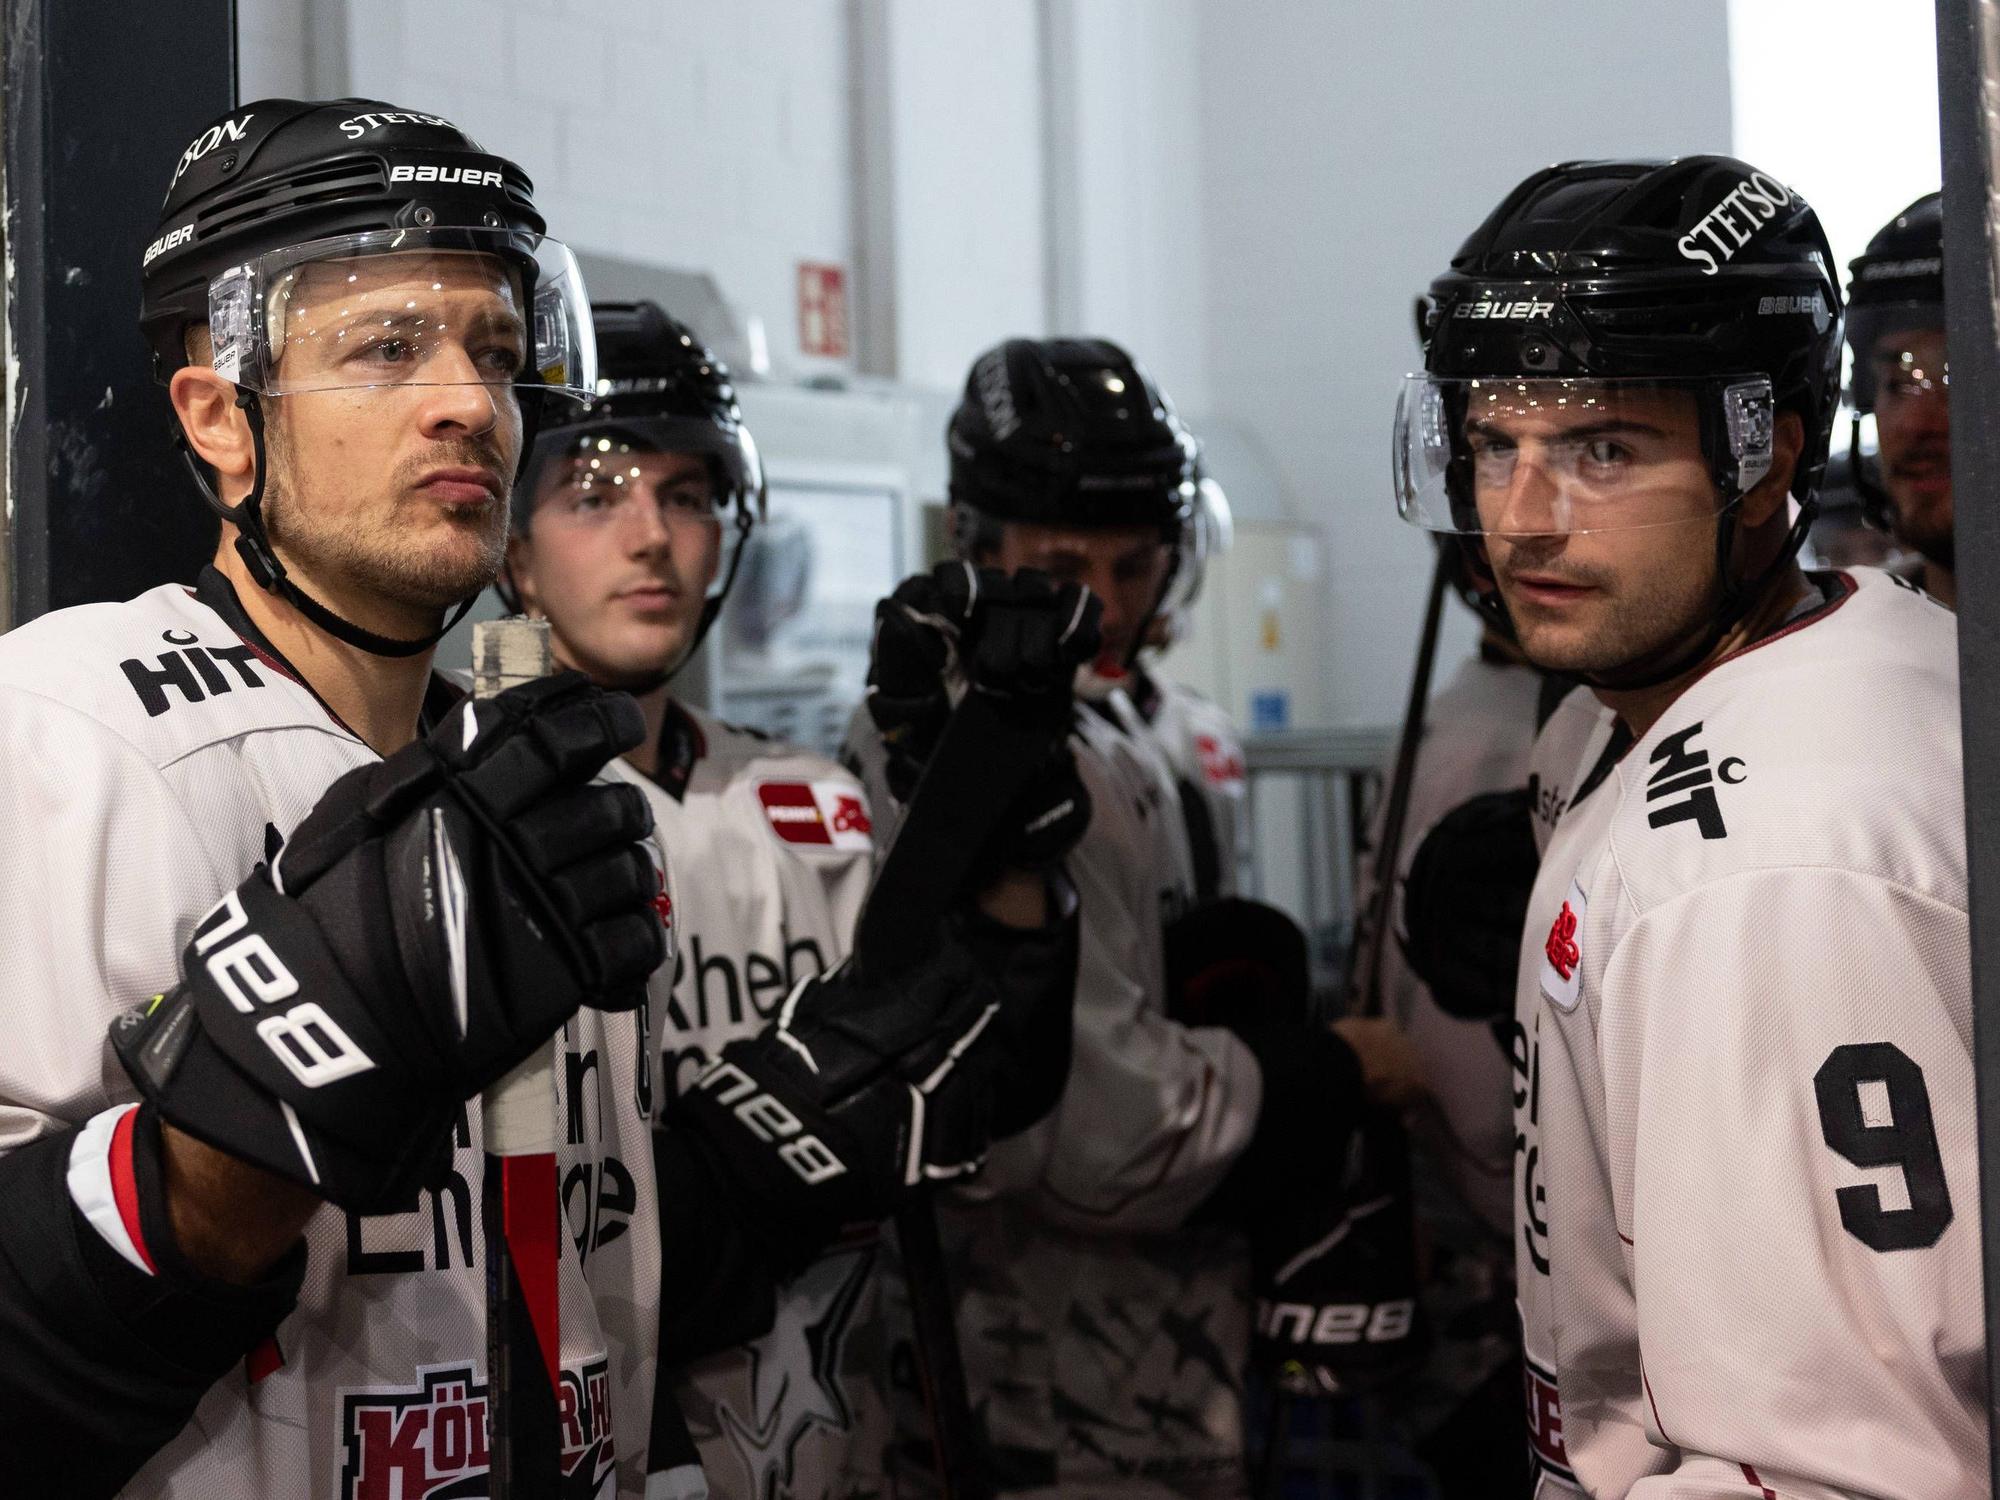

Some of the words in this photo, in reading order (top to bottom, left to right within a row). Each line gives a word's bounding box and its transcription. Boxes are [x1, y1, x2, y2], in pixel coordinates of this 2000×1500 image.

[339, 112, 482, 149] STETS
[390, 165, 503, 188] BAUER
[143, 223, 194, 267] BAUER
[1678, 171, 1802, 276] STETSO
[1452, 301, 1555, 319] BAUER
[1757, 296, 1821, 315] BAUER
[119, 629, 266, 717] HIT
[1646, 720, 1747, 839] HIT
[193, 890, 378, 1088] BAU
[699, 1056, 848, 1185] BAU
[1813, 1041, 1954, 1253] 9
[1258, 1299, 1415, 1344] BAU
